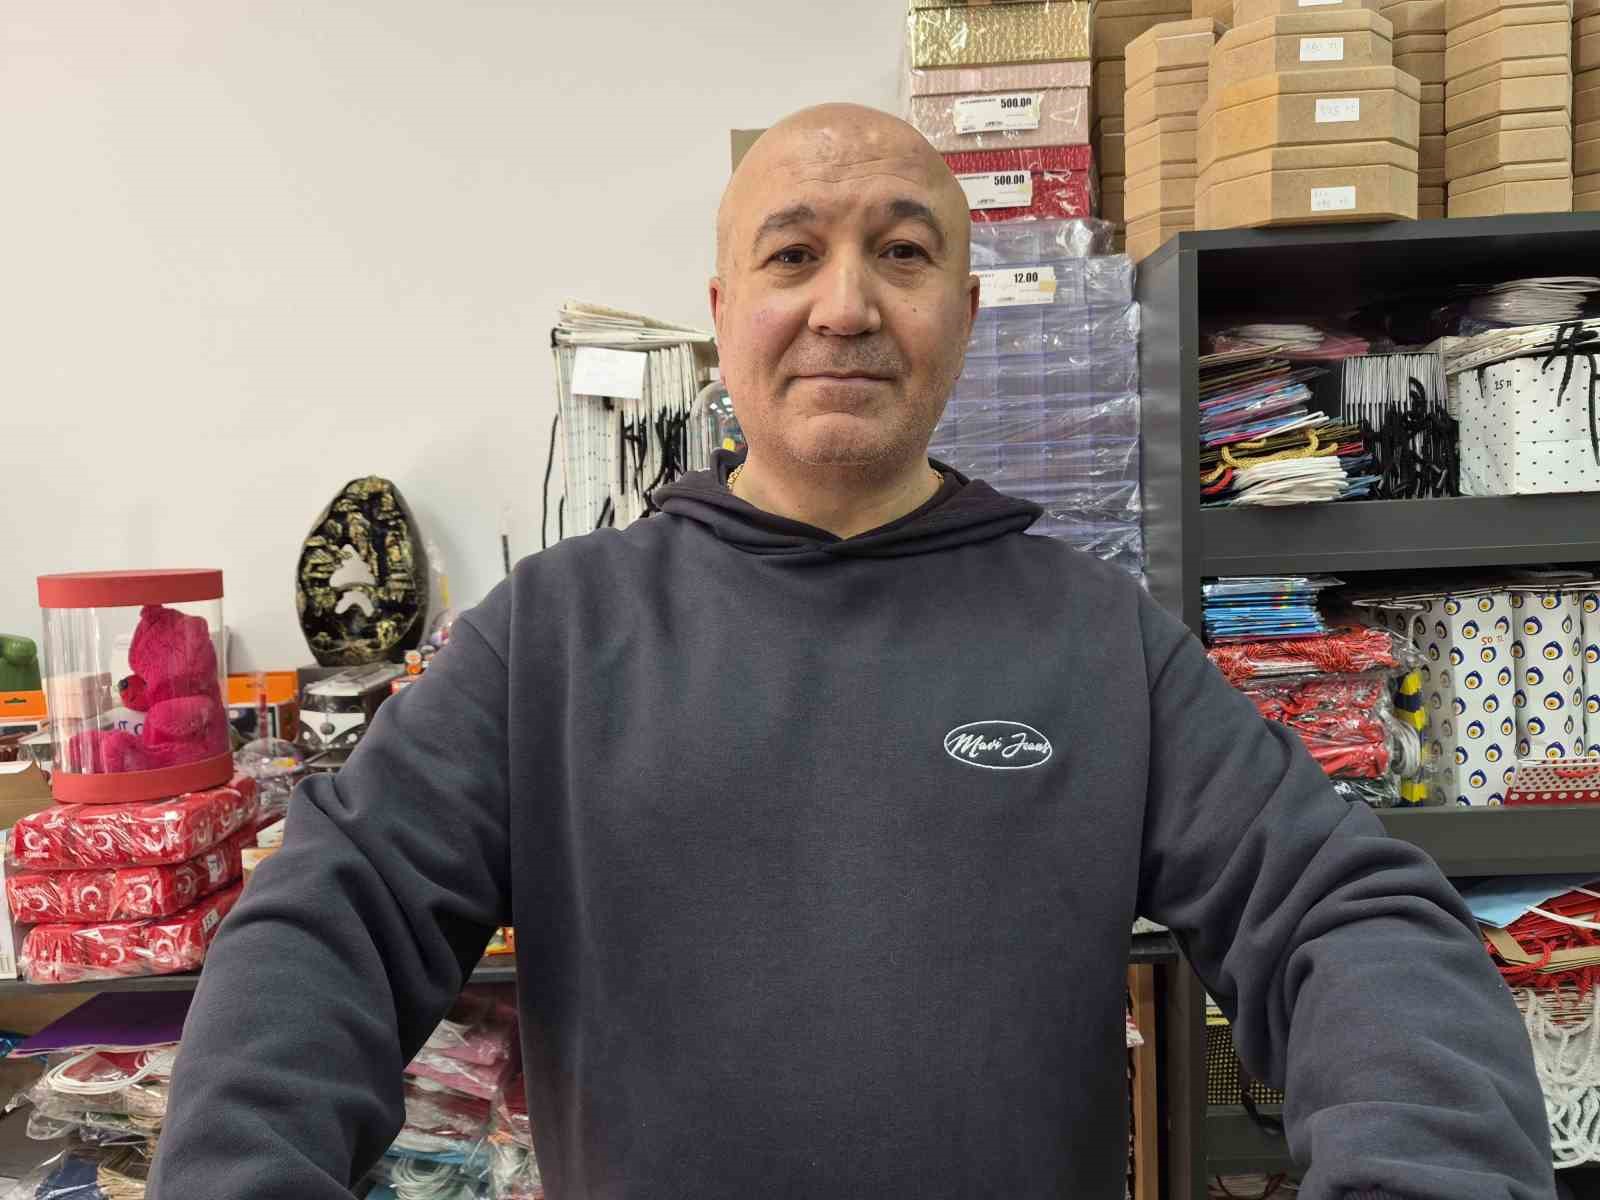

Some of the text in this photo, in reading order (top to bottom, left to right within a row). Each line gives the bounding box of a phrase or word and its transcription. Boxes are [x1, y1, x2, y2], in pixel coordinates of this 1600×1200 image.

[1001, 98, 1032, 109] 500.00
[994, 174, 1025, 186] 500.00
[1014, 272, 1039, 284] 12.00
